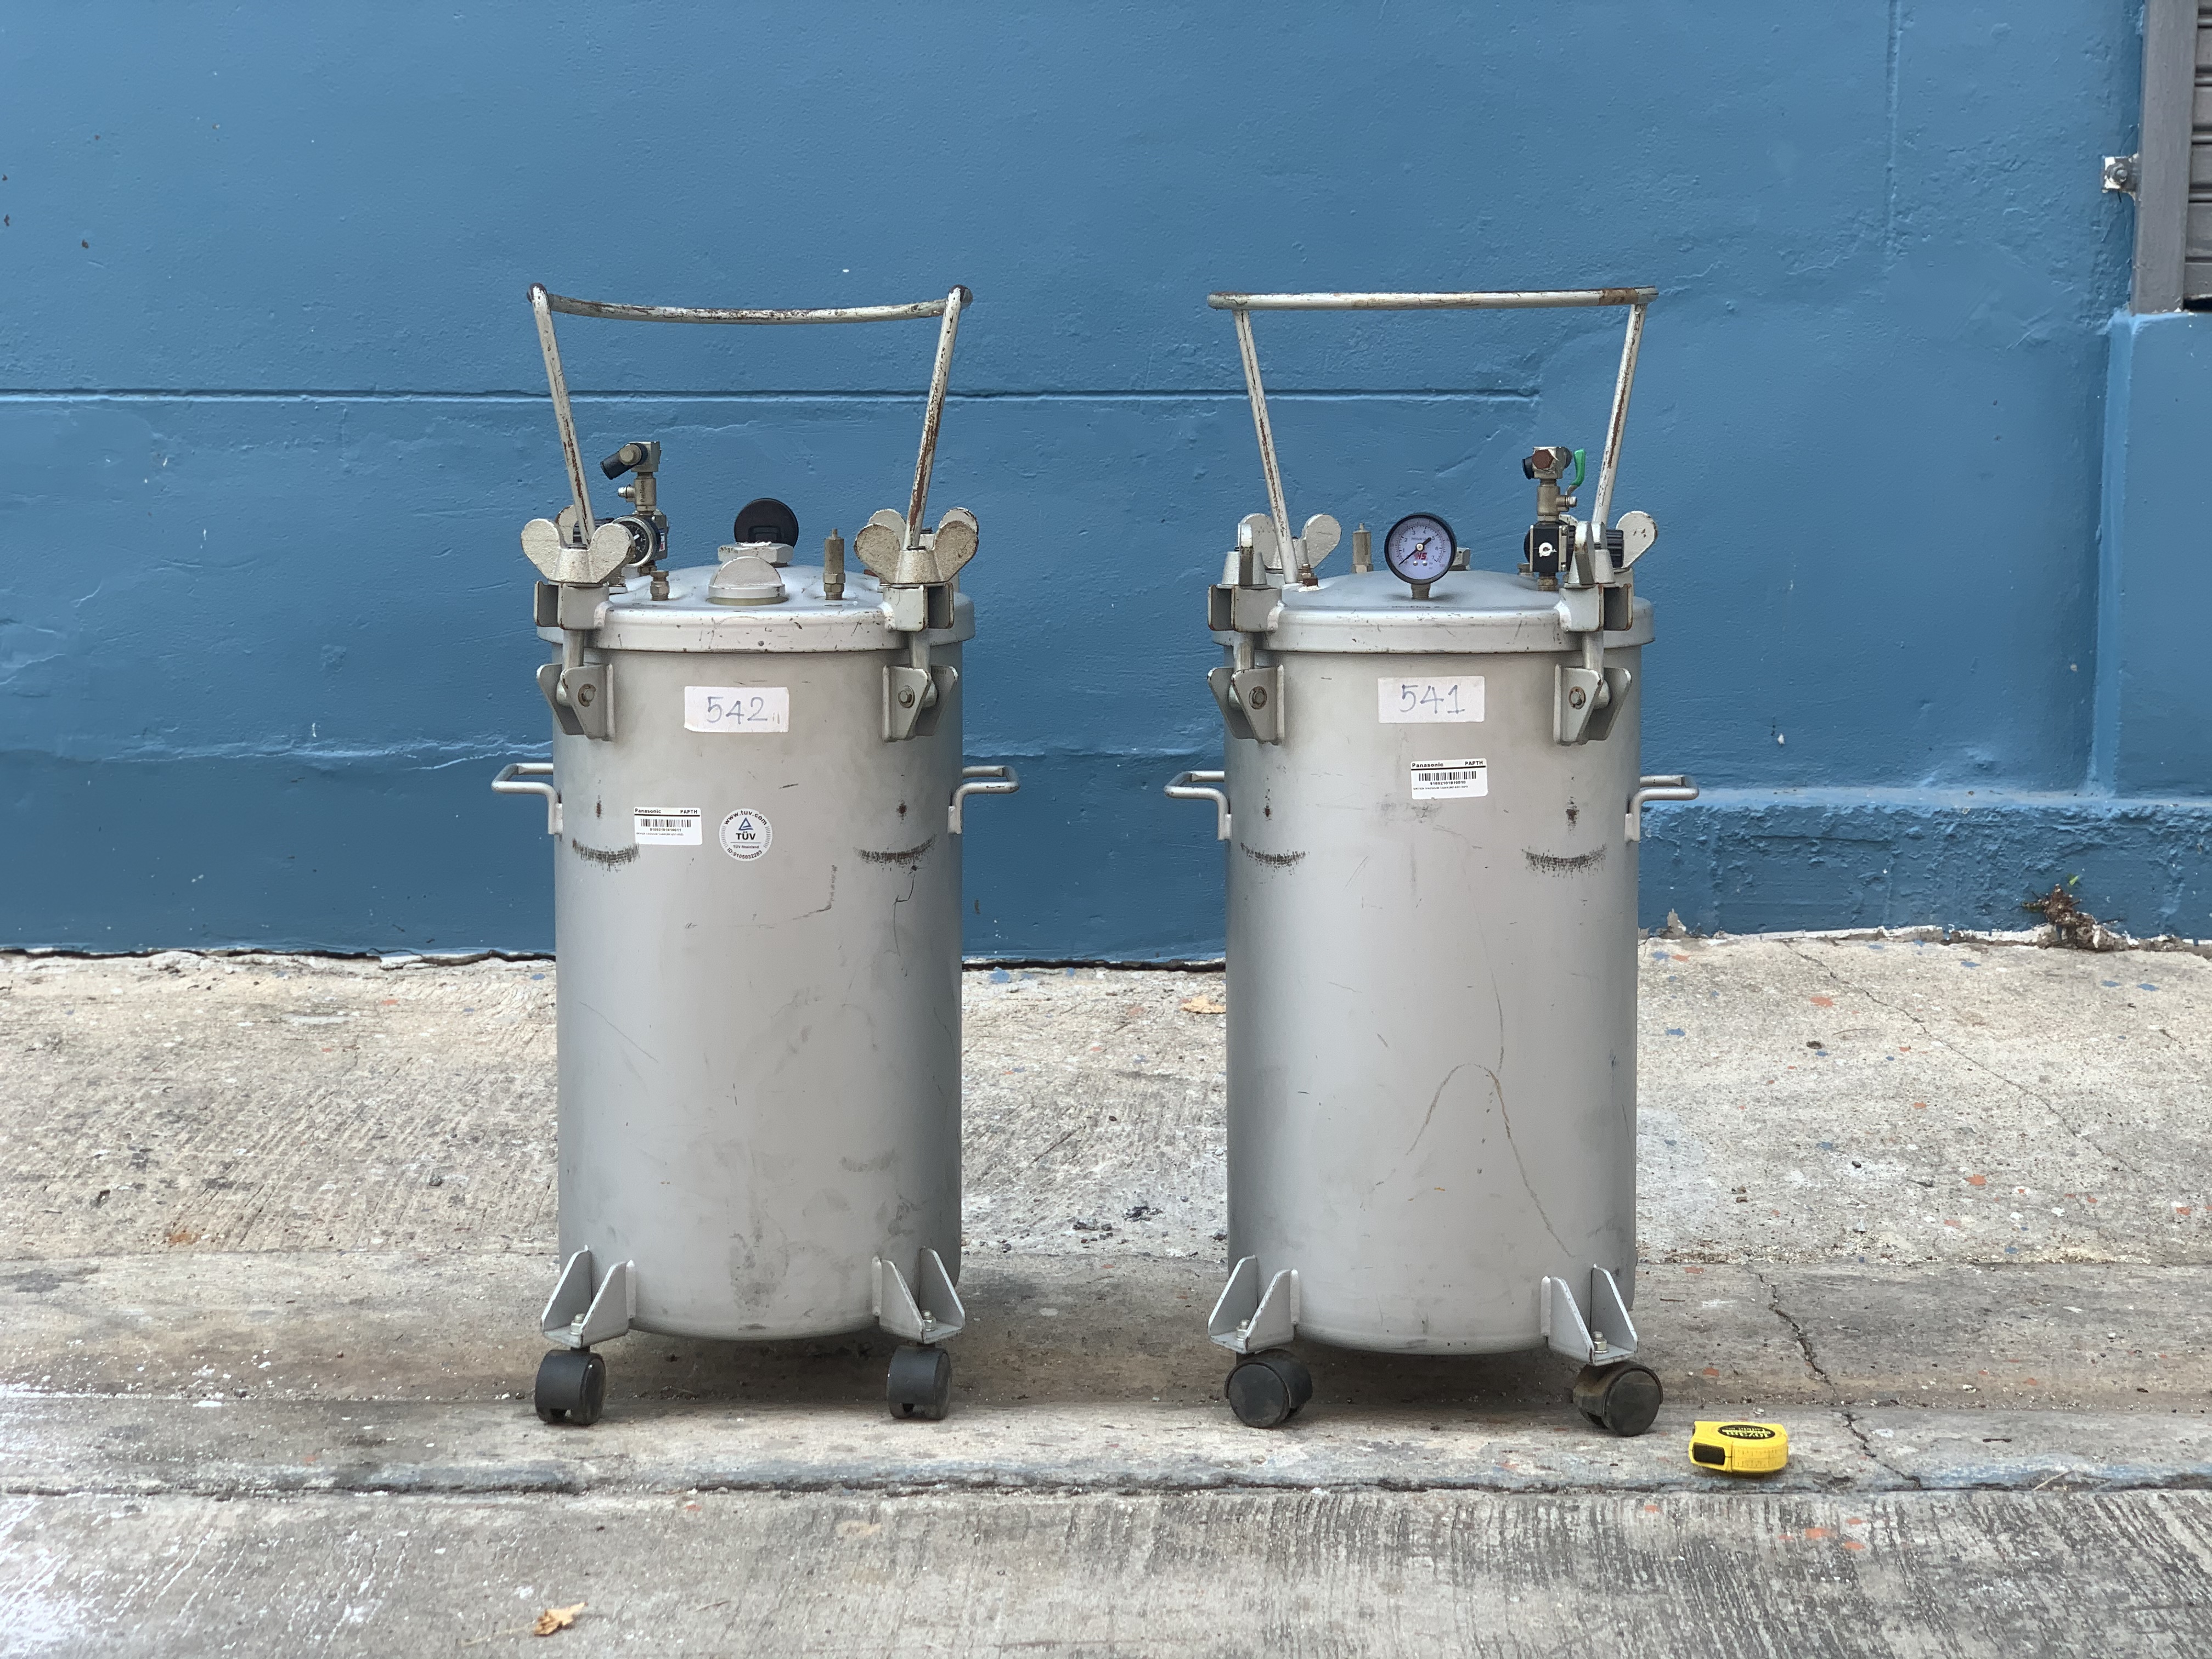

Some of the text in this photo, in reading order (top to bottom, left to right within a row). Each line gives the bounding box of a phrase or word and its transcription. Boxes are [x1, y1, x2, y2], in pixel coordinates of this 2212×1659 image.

[1400, 684, 1465, 714] 541
[706, 696, 768, 725] 542
[724, 810, 767, 825] www.tuv.com
[736, 831, 756, 840] TÜV
